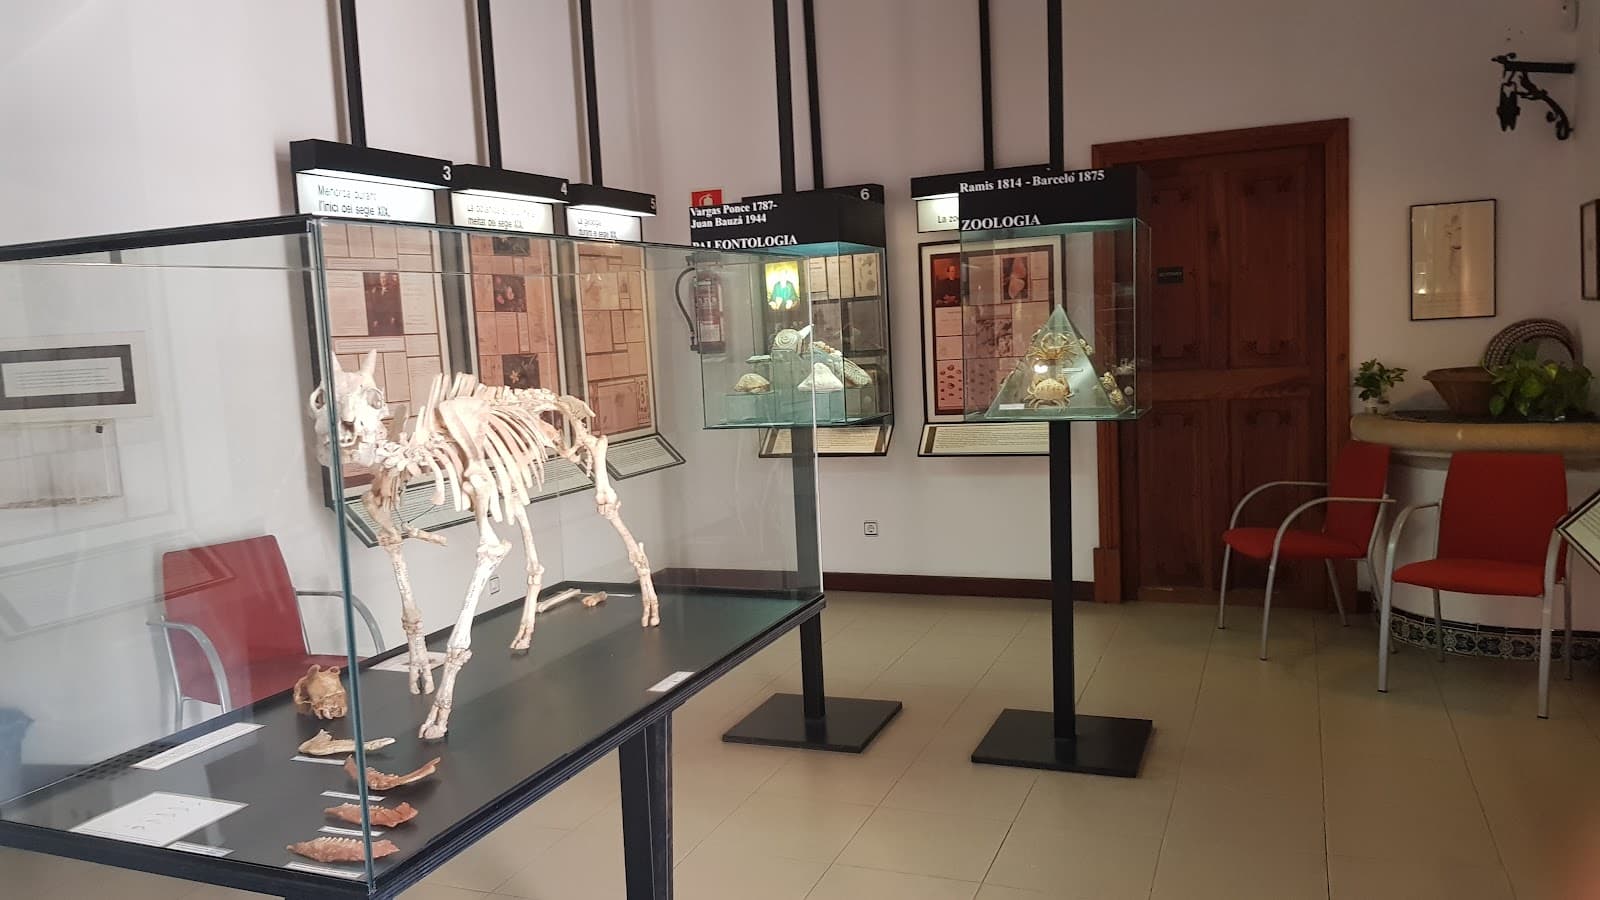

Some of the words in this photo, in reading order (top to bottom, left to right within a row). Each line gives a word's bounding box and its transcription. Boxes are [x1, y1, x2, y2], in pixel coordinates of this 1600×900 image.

[442, 165, 452, 181] 3
[960, 181, 994, 193] Ramis
[997, 177, 1022, 190] 1814
[1032, 172, 1076, 187] Barceló
[1078, 169, 1105, 183] 1875
[560, 182, 568, 196] 4
[860, 188, 870, 200] 6
[690, 207, 722, 218] Vargas
[723, 204, 751, 214] Ponce
[752, 200, 779, 212] 1787-
[691, 219, 713, 229] Juan
[715, 215, 744, 227] Bauzá
[745, 212, 767, 224] 1944
[961, 214, 1041, 231] ZOOLOGIA
